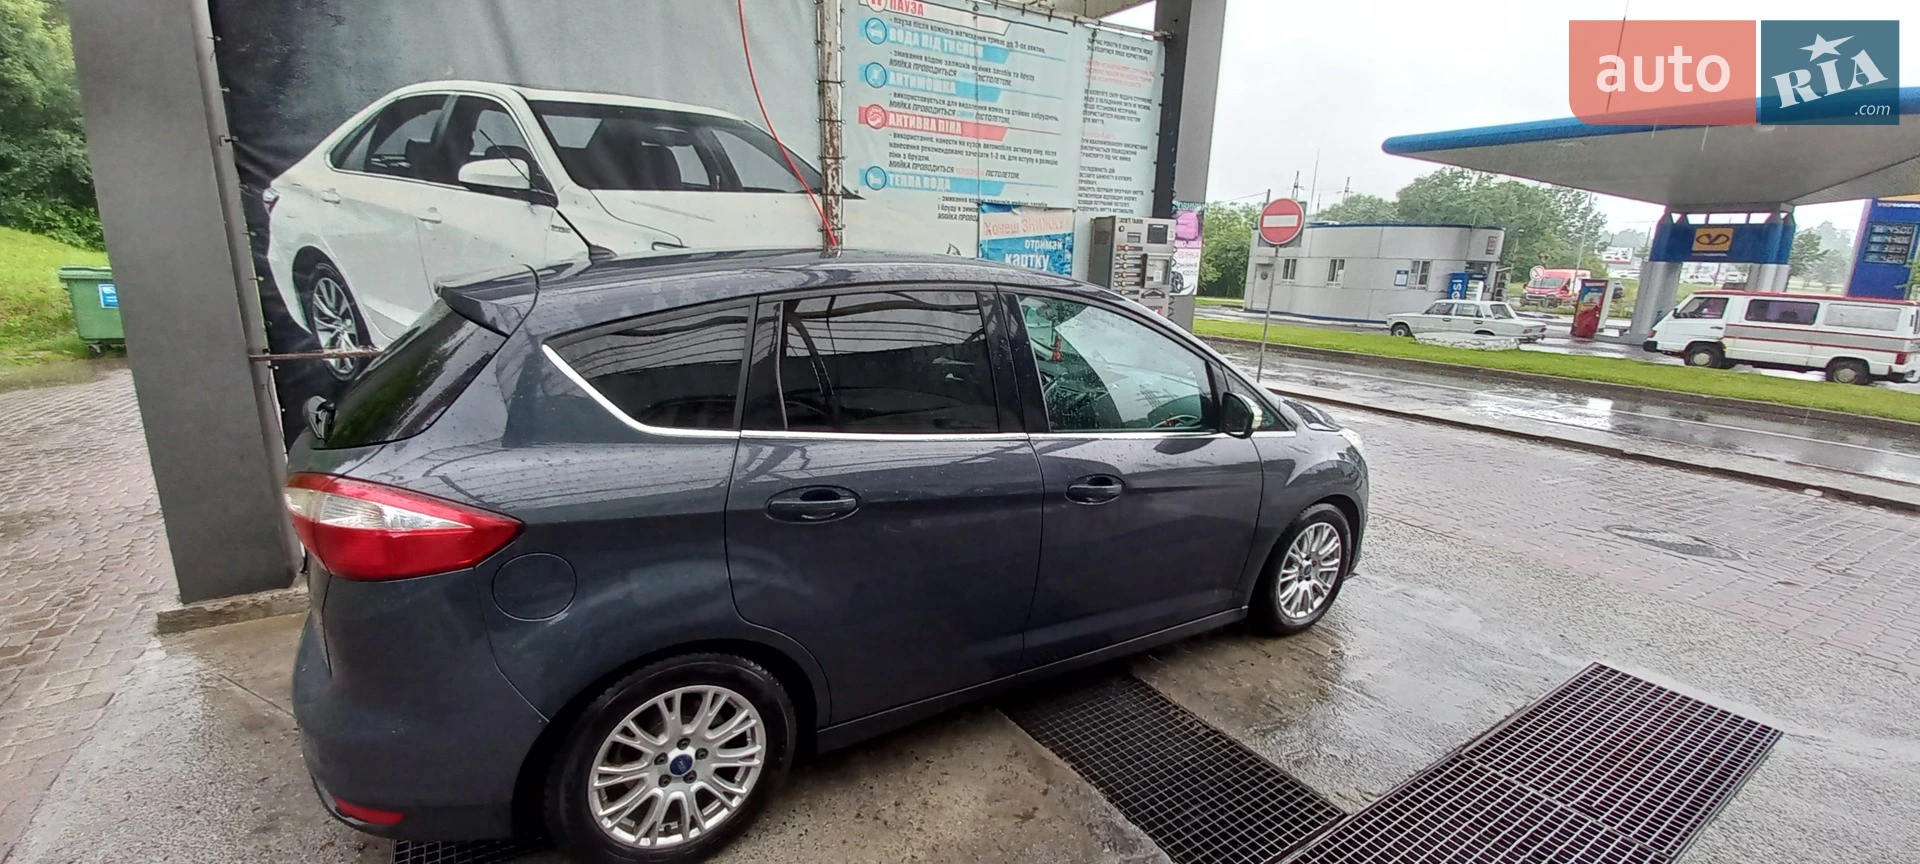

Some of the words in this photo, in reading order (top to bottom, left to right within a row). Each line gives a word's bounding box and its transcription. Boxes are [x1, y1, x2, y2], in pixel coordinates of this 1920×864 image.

[890, 0, 924, 16] ПАУЗА
[889, 27, 920, 47] ВОДА
[921, 33, 941, 52] ПІД
[889, 112, 937, 132] АКТИВНА
[938, 119, 962, 134] ПІНА
[889, 173, 921, 188] ТЕПЛА
[922, 176, 952, 192] ВОДА
[984, 221, 1019, 236] Хочеш
[1024, 239, 1063, 251] отримай
[1004, 253, 1050, 272] картку
